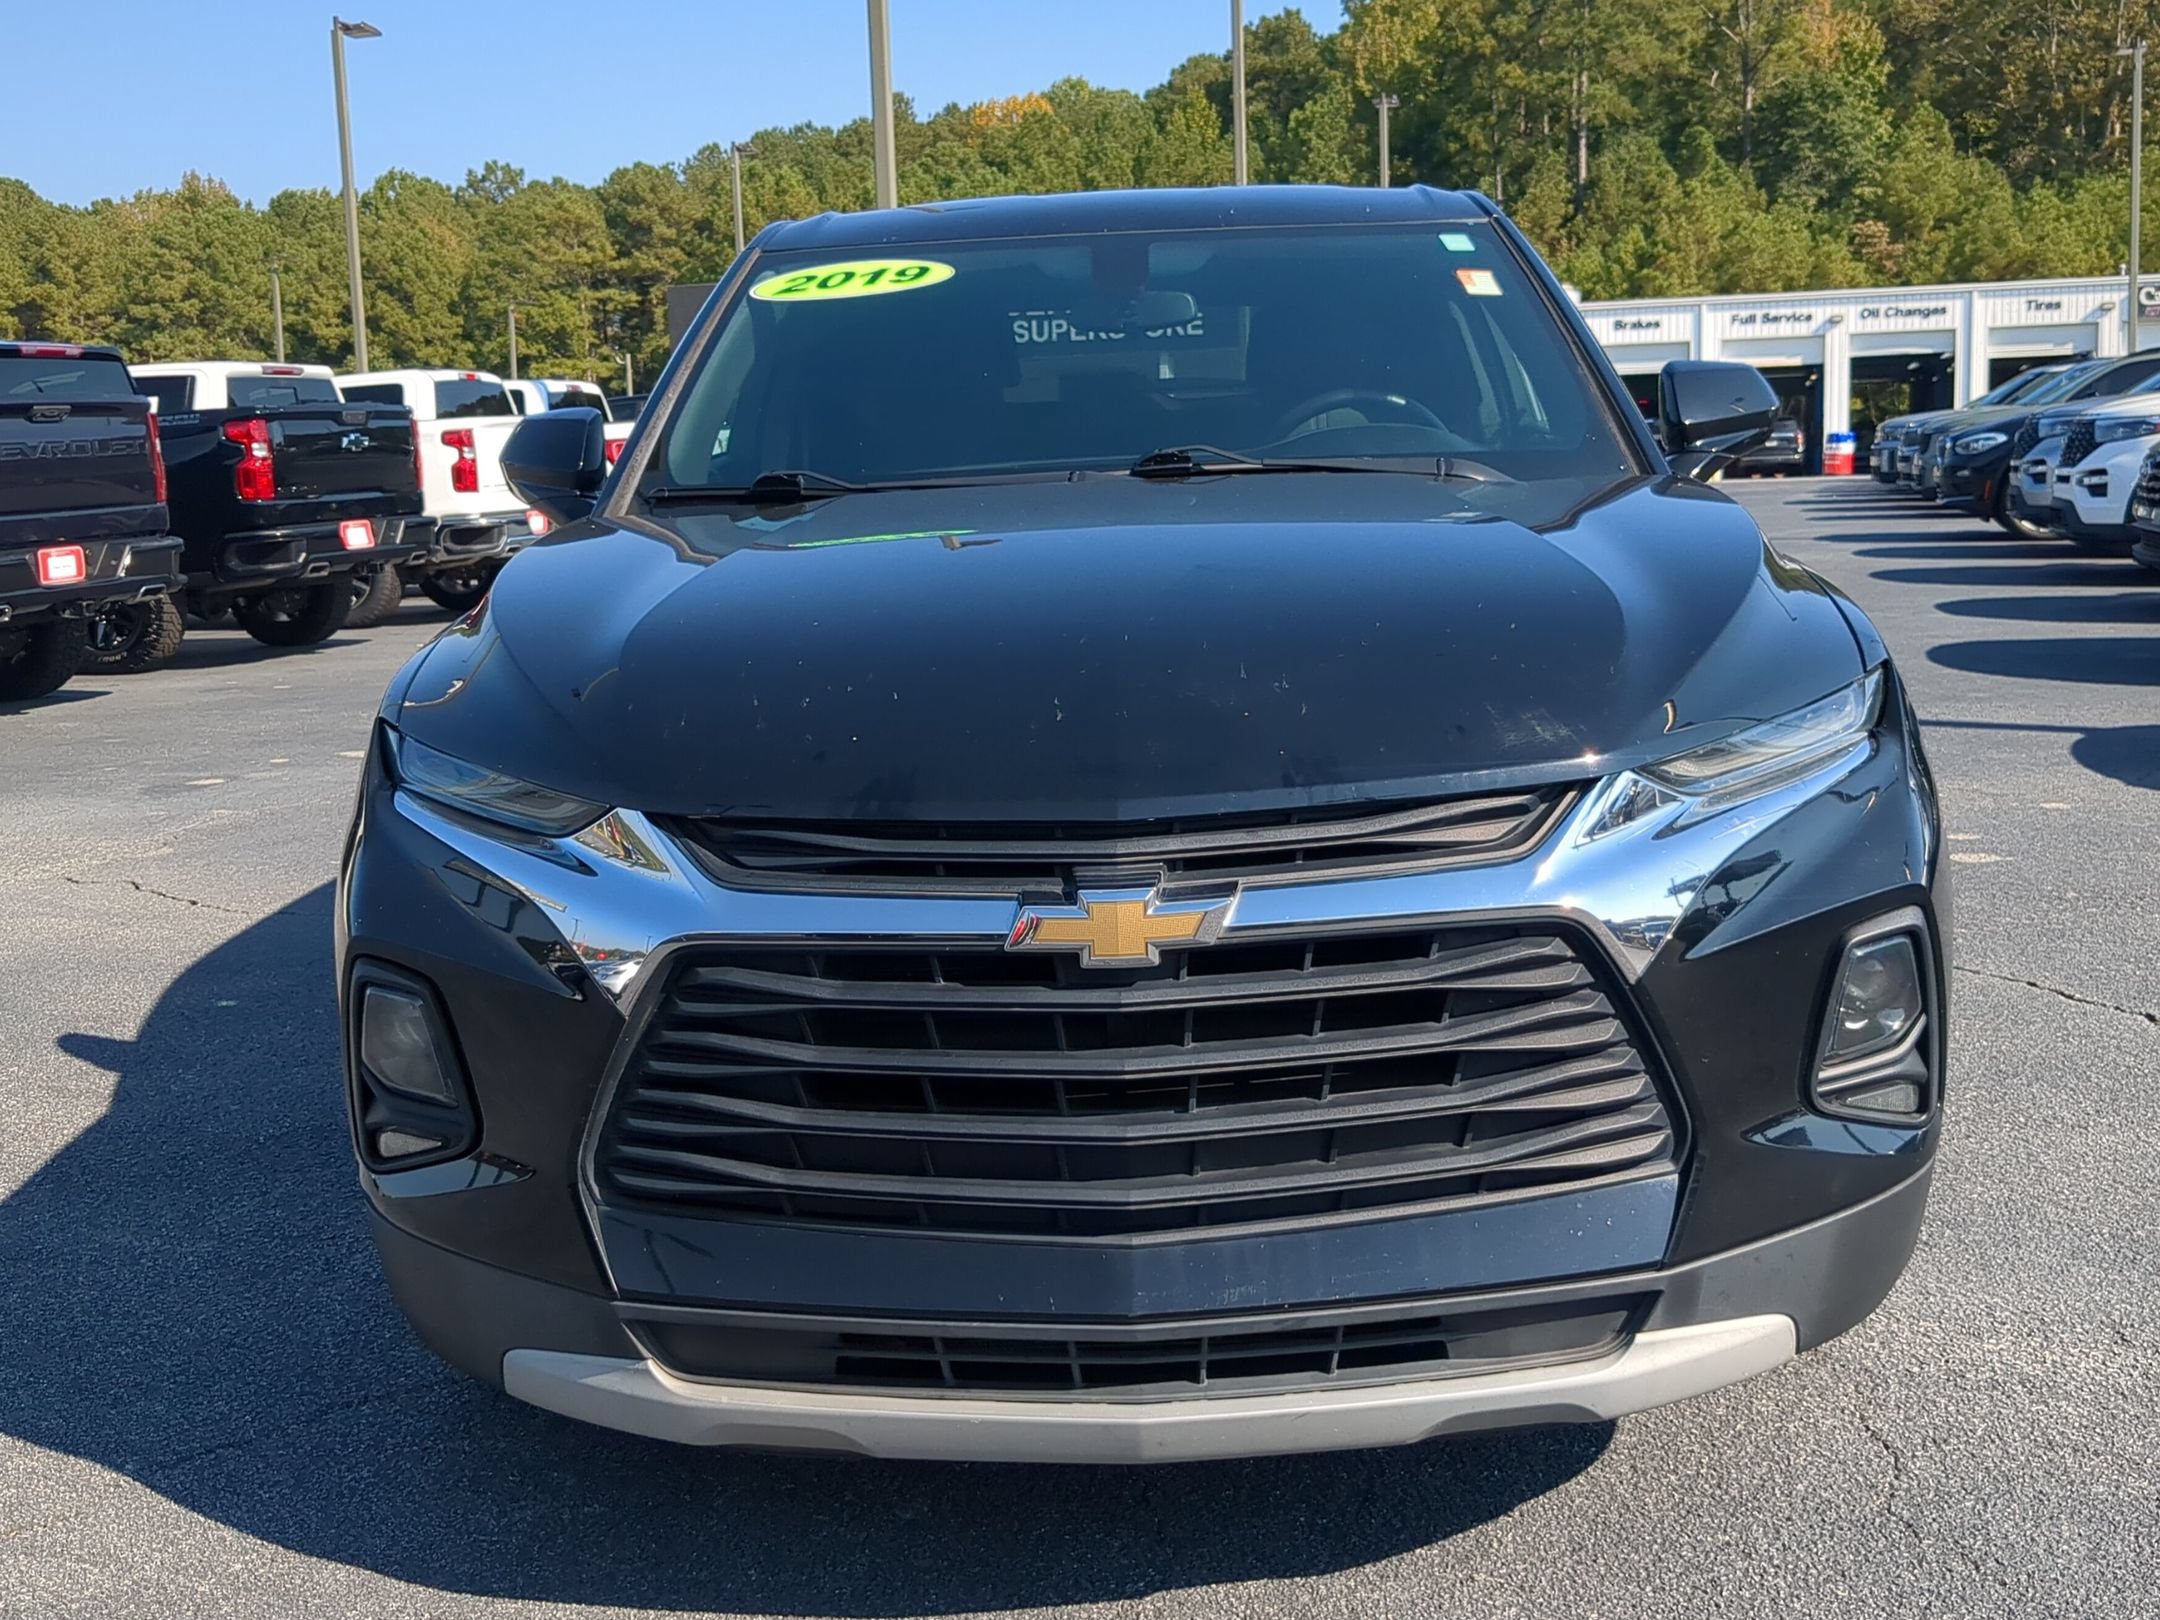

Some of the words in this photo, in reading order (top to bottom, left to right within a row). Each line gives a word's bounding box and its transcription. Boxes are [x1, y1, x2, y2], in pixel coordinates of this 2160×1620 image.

[771, 265, 932, 296] 2019
[1860, 307, 1880, 320] Oil
[1884, 304, 1947, 320] Changes
[2025, 299, 2062, 312] Tires
[1613, 318, 1661, 331] Brakes
[1731, 312, 1757, 326] Full
[1761, 311, 1813, 325] Service
